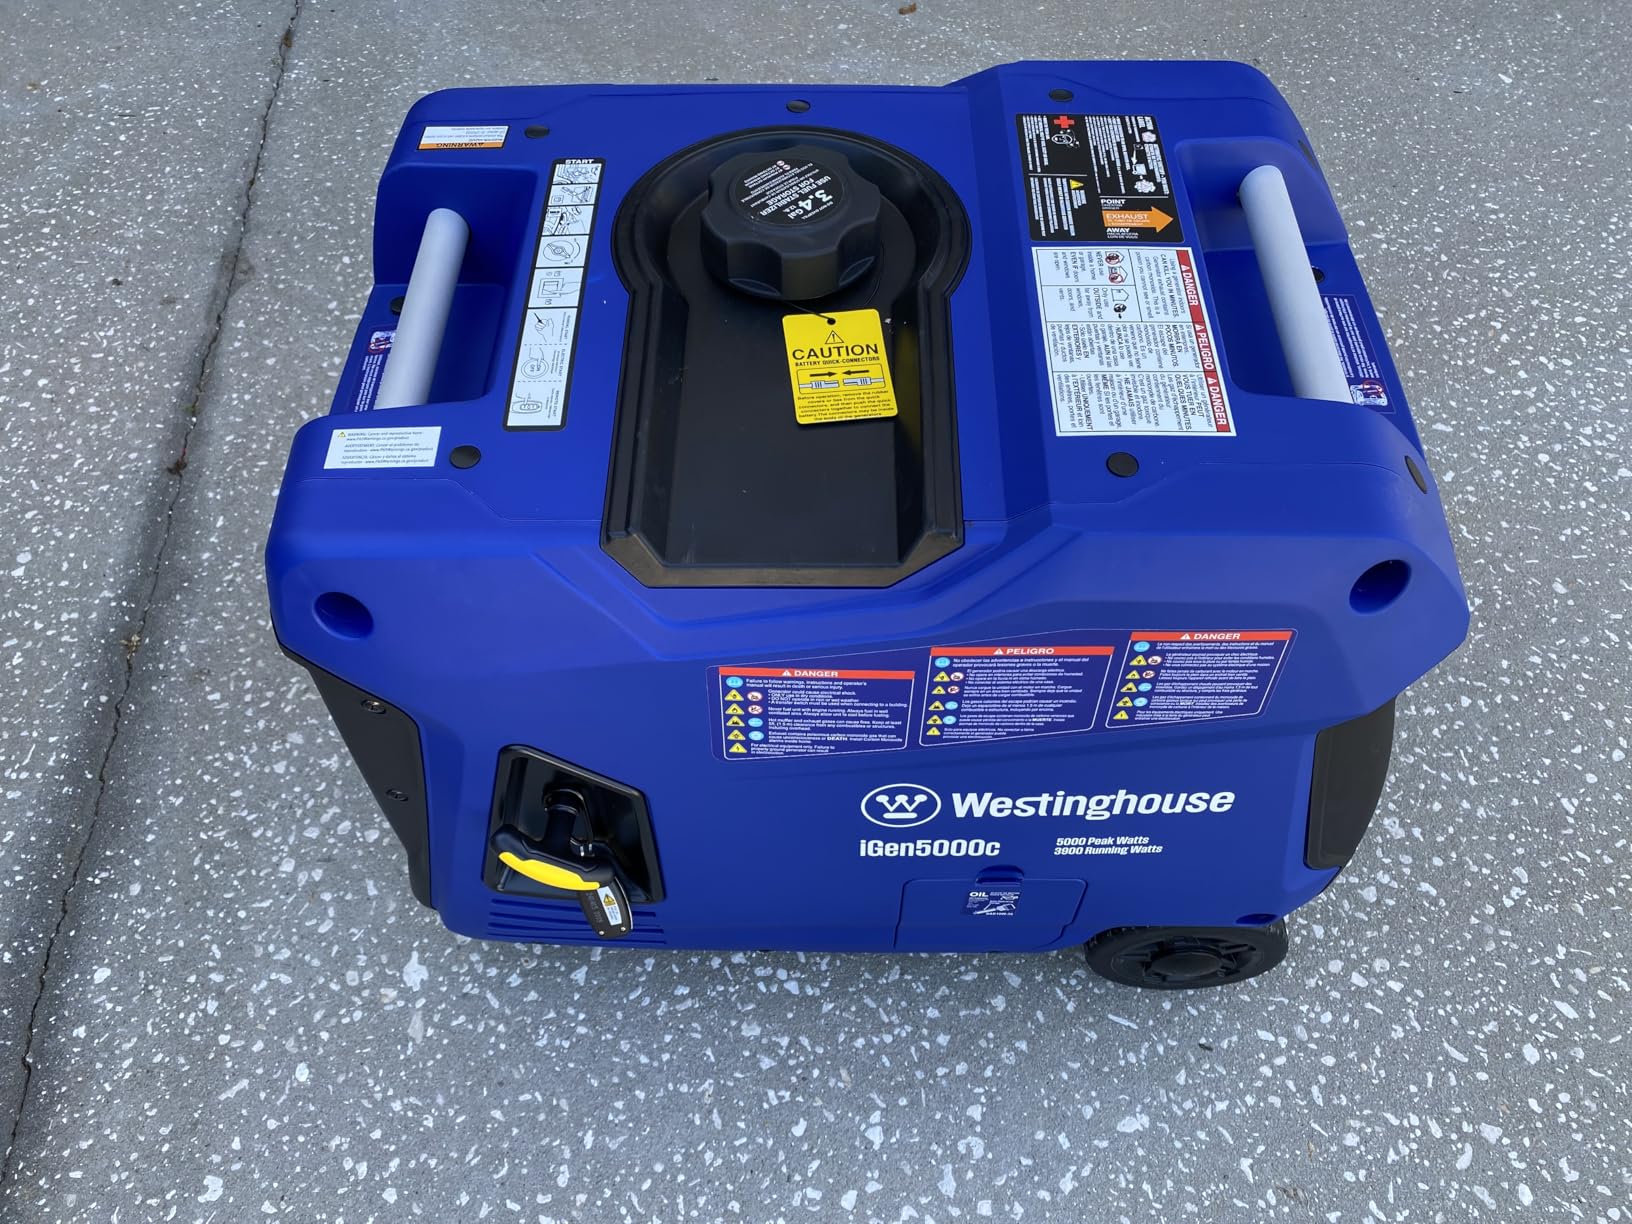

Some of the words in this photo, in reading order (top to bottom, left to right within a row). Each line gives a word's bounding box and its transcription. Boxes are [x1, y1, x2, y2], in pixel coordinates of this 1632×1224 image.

[798, 178, 814, 186] FOR
[798, 183, 816, 194] FUEL
[815, 176, 831, 185] USE
[760, 193, 799, 216] STABILIZER
[765, 186, 799, 205] STORAGE
[798, 190, 832, 211] 3.4
[788, 209, 803, 219] Gal
[1095, 251, 1103, 266] NEVER
[1182, 272, 1199, 305] DANGER
[1092, 287, 1102, 309] OUTSIDE
[1071, 324, 1082, 356] EXTERIORES
[1114, 327, 1123, 344] NUNCA
[1164, 324, 1173, 342] POCOS
[792, 344, 878, 360] CAUTION
[1196, 332, 1214, 369] PELIGRO
[1174, 374, 1186, 403] QUELQUES
[1181, 374, 1191, 389] VOUS
[1125, 386, 1134, 407] JAMAIS
[1185, 391, 1194, 405] TUER
[1208, 386, 1227, 424] DANGER
[1195, 402, 1204, 417] PEUT
[952, 789, 1235, 821] Westinghouse
[860, 839, 1000, 857] iGen5000c
[1056, 837, 1086, 845] 5000
[1088, 837, 1115, 845] Peak
[1117, 836, 1149, 845] Watts
[1054, 847, 1084, 855] 3900
[1085, 846, 1128, 856] Running
[1130, 845, 1163, 854] Watts
